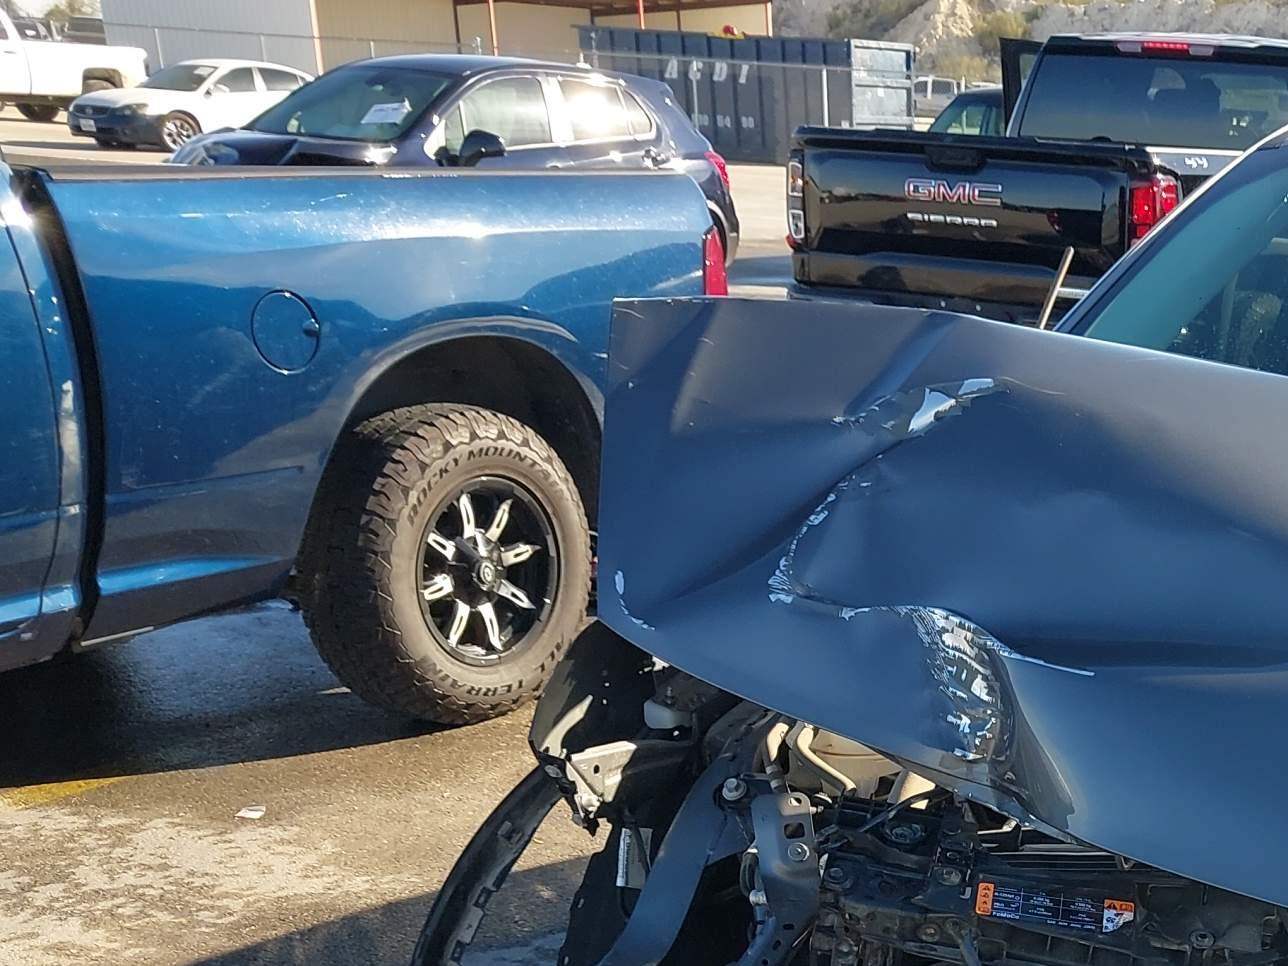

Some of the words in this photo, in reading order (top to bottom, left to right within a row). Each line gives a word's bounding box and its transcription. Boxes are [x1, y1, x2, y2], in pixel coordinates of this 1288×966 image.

[905, 177, 1002, 206] GMC
[906, 212, 998, 228] SIERRA
[406, 453, 463, 527] ROCKY
